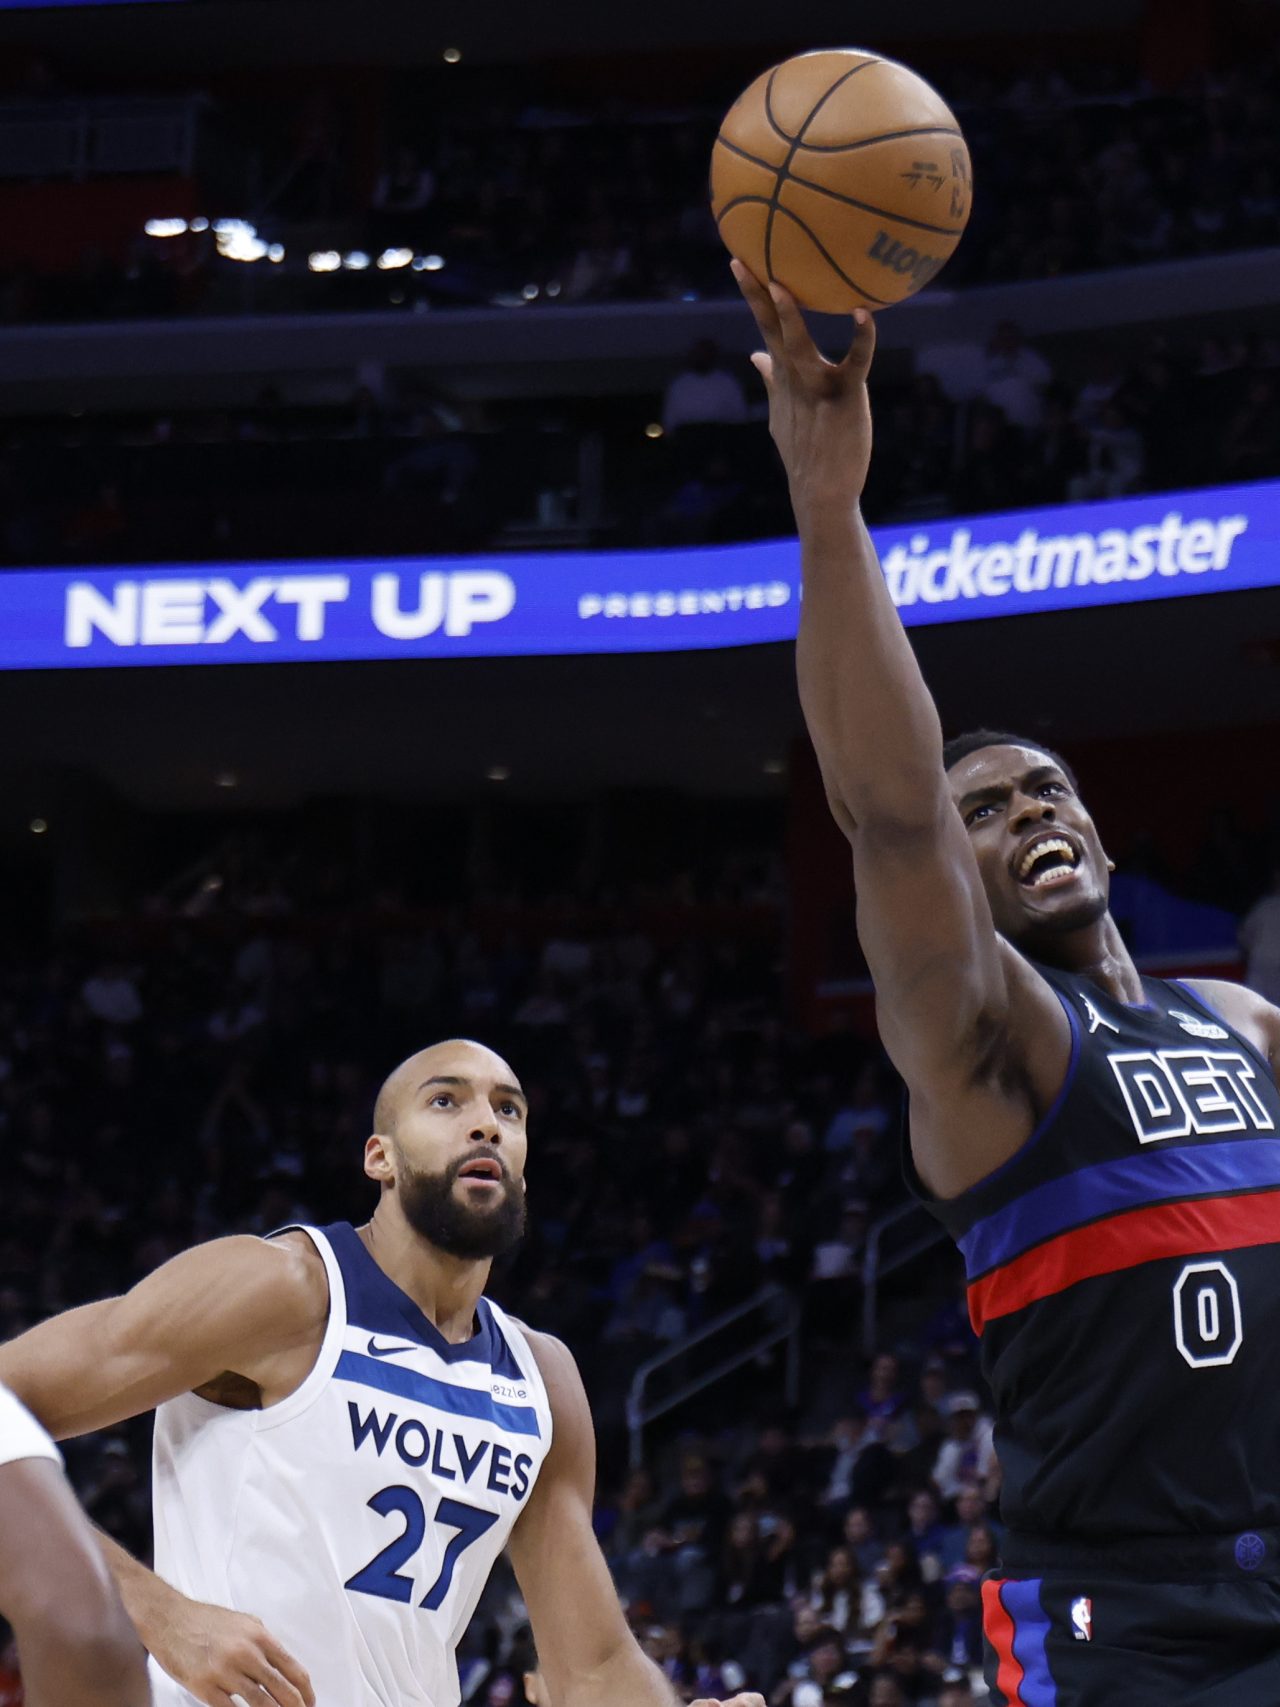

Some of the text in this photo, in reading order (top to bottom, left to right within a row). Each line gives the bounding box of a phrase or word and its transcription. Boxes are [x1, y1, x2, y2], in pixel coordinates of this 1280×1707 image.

[65, 511, 1248, 648] NEXT UP PRESENTED ticketmaster
[1106, 1049, 1275, 1145] DET
[1173, 1261, 1243, 1369] 0
[347, 1400, 534, 1501] WOLVES
[343, 1484, 500, 1612] 27
